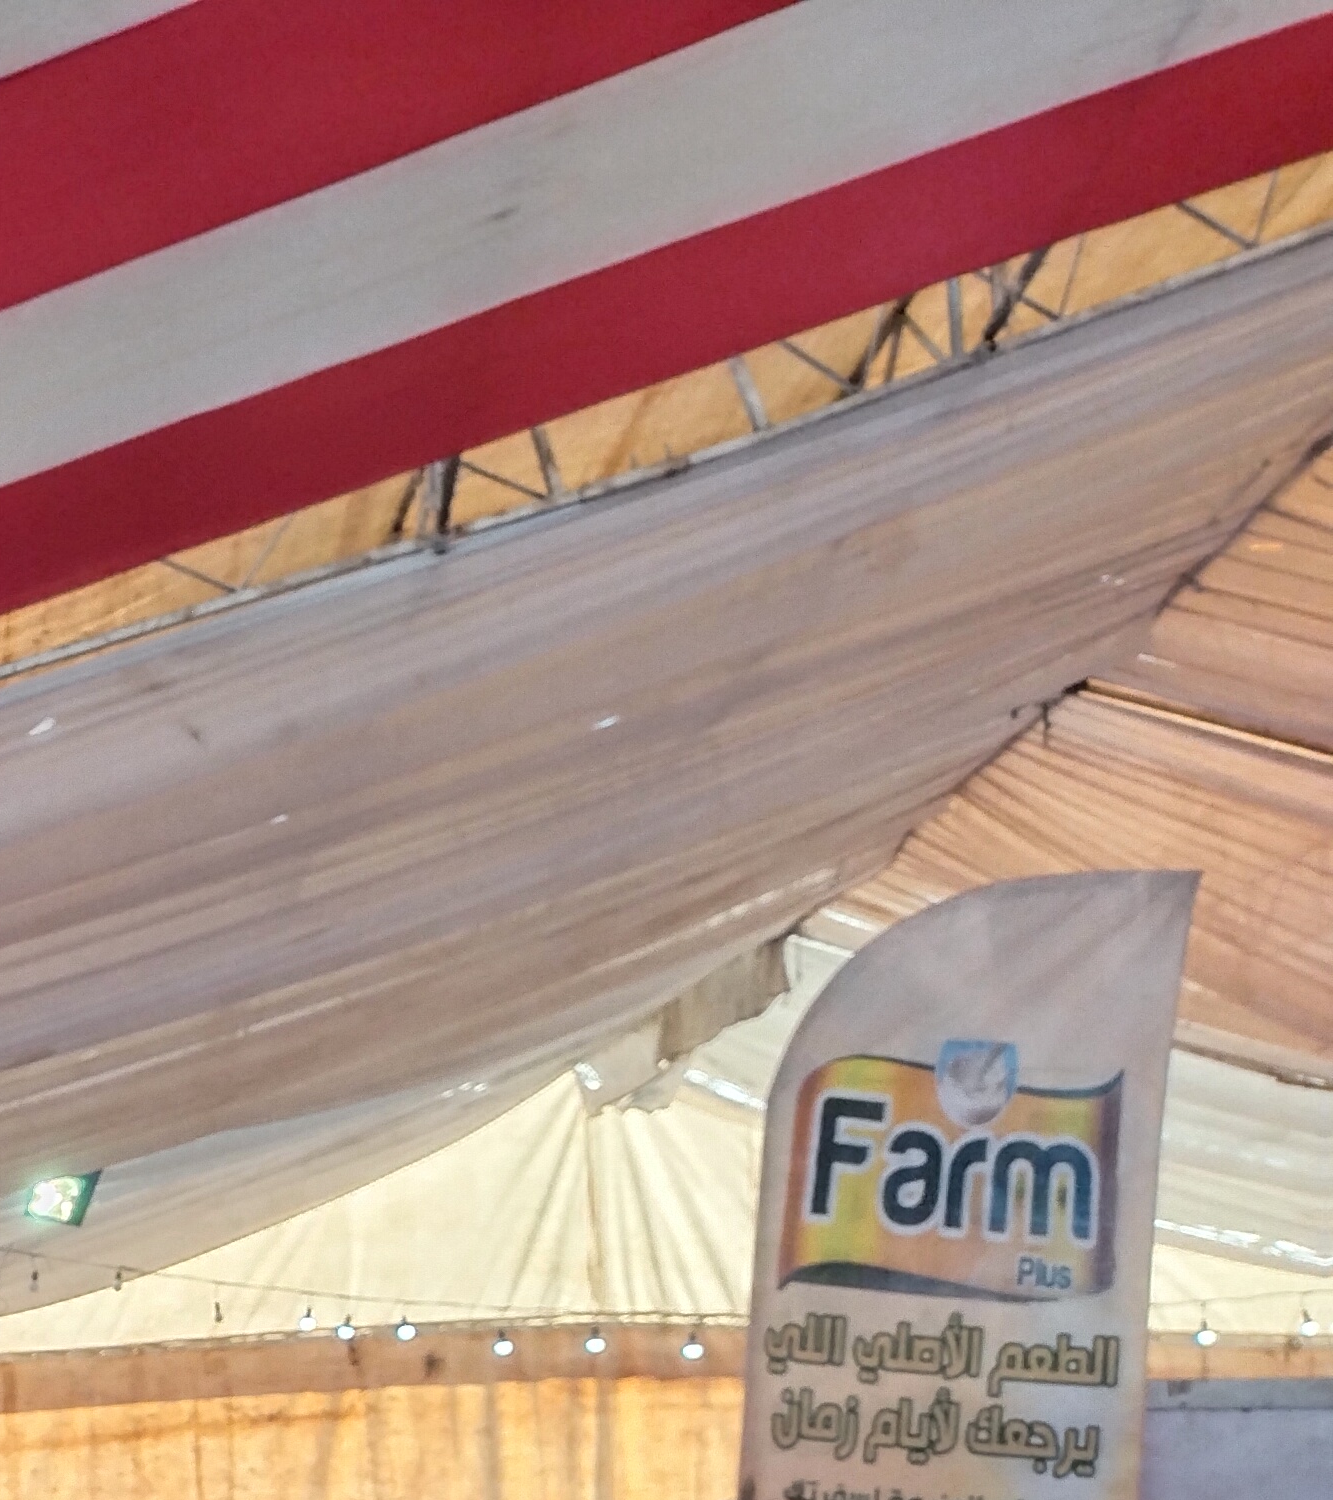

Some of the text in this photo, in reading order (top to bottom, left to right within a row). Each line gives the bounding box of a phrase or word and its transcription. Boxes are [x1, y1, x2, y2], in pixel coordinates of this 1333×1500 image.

[810, 1096, 1096, 1240] Farm
[1016, 1256, 1073, 1290] Plus
[763, 1311, 1121, 1398] الطعم الأصلي اللي
[769, 1384, 1102, 1479] يرجعك لأيام زمان
